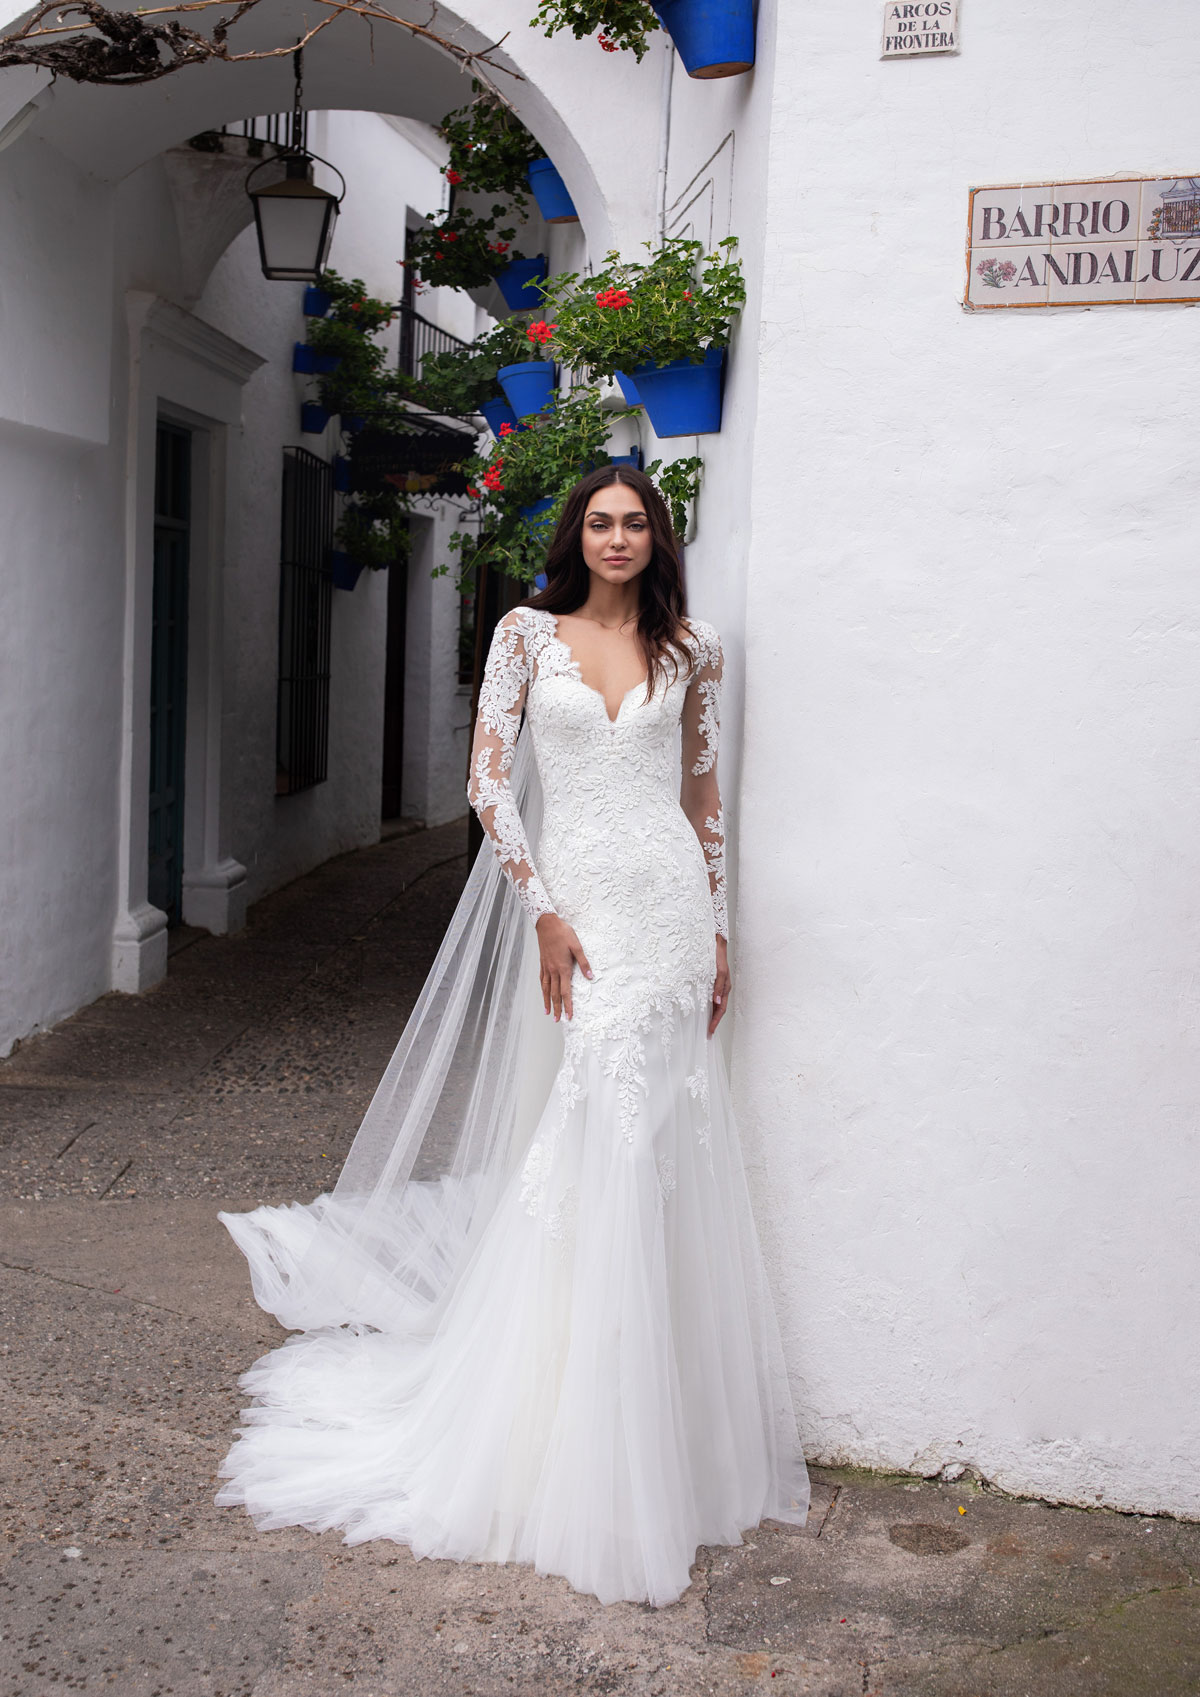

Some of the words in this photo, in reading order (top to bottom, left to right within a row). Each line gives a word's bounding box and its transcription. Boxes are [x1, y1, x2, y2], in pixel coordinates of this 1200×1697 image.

[889, 2, 952, 19] ARCOS
[897, 21, 917, 32] DE
[922, 20, 940, 31] LA
[885, 32, 954, 51] FRONTERA
[979, 200, 1130, 240] BARRIO
[1014, 247, 1200, 287] ANDALUZ
